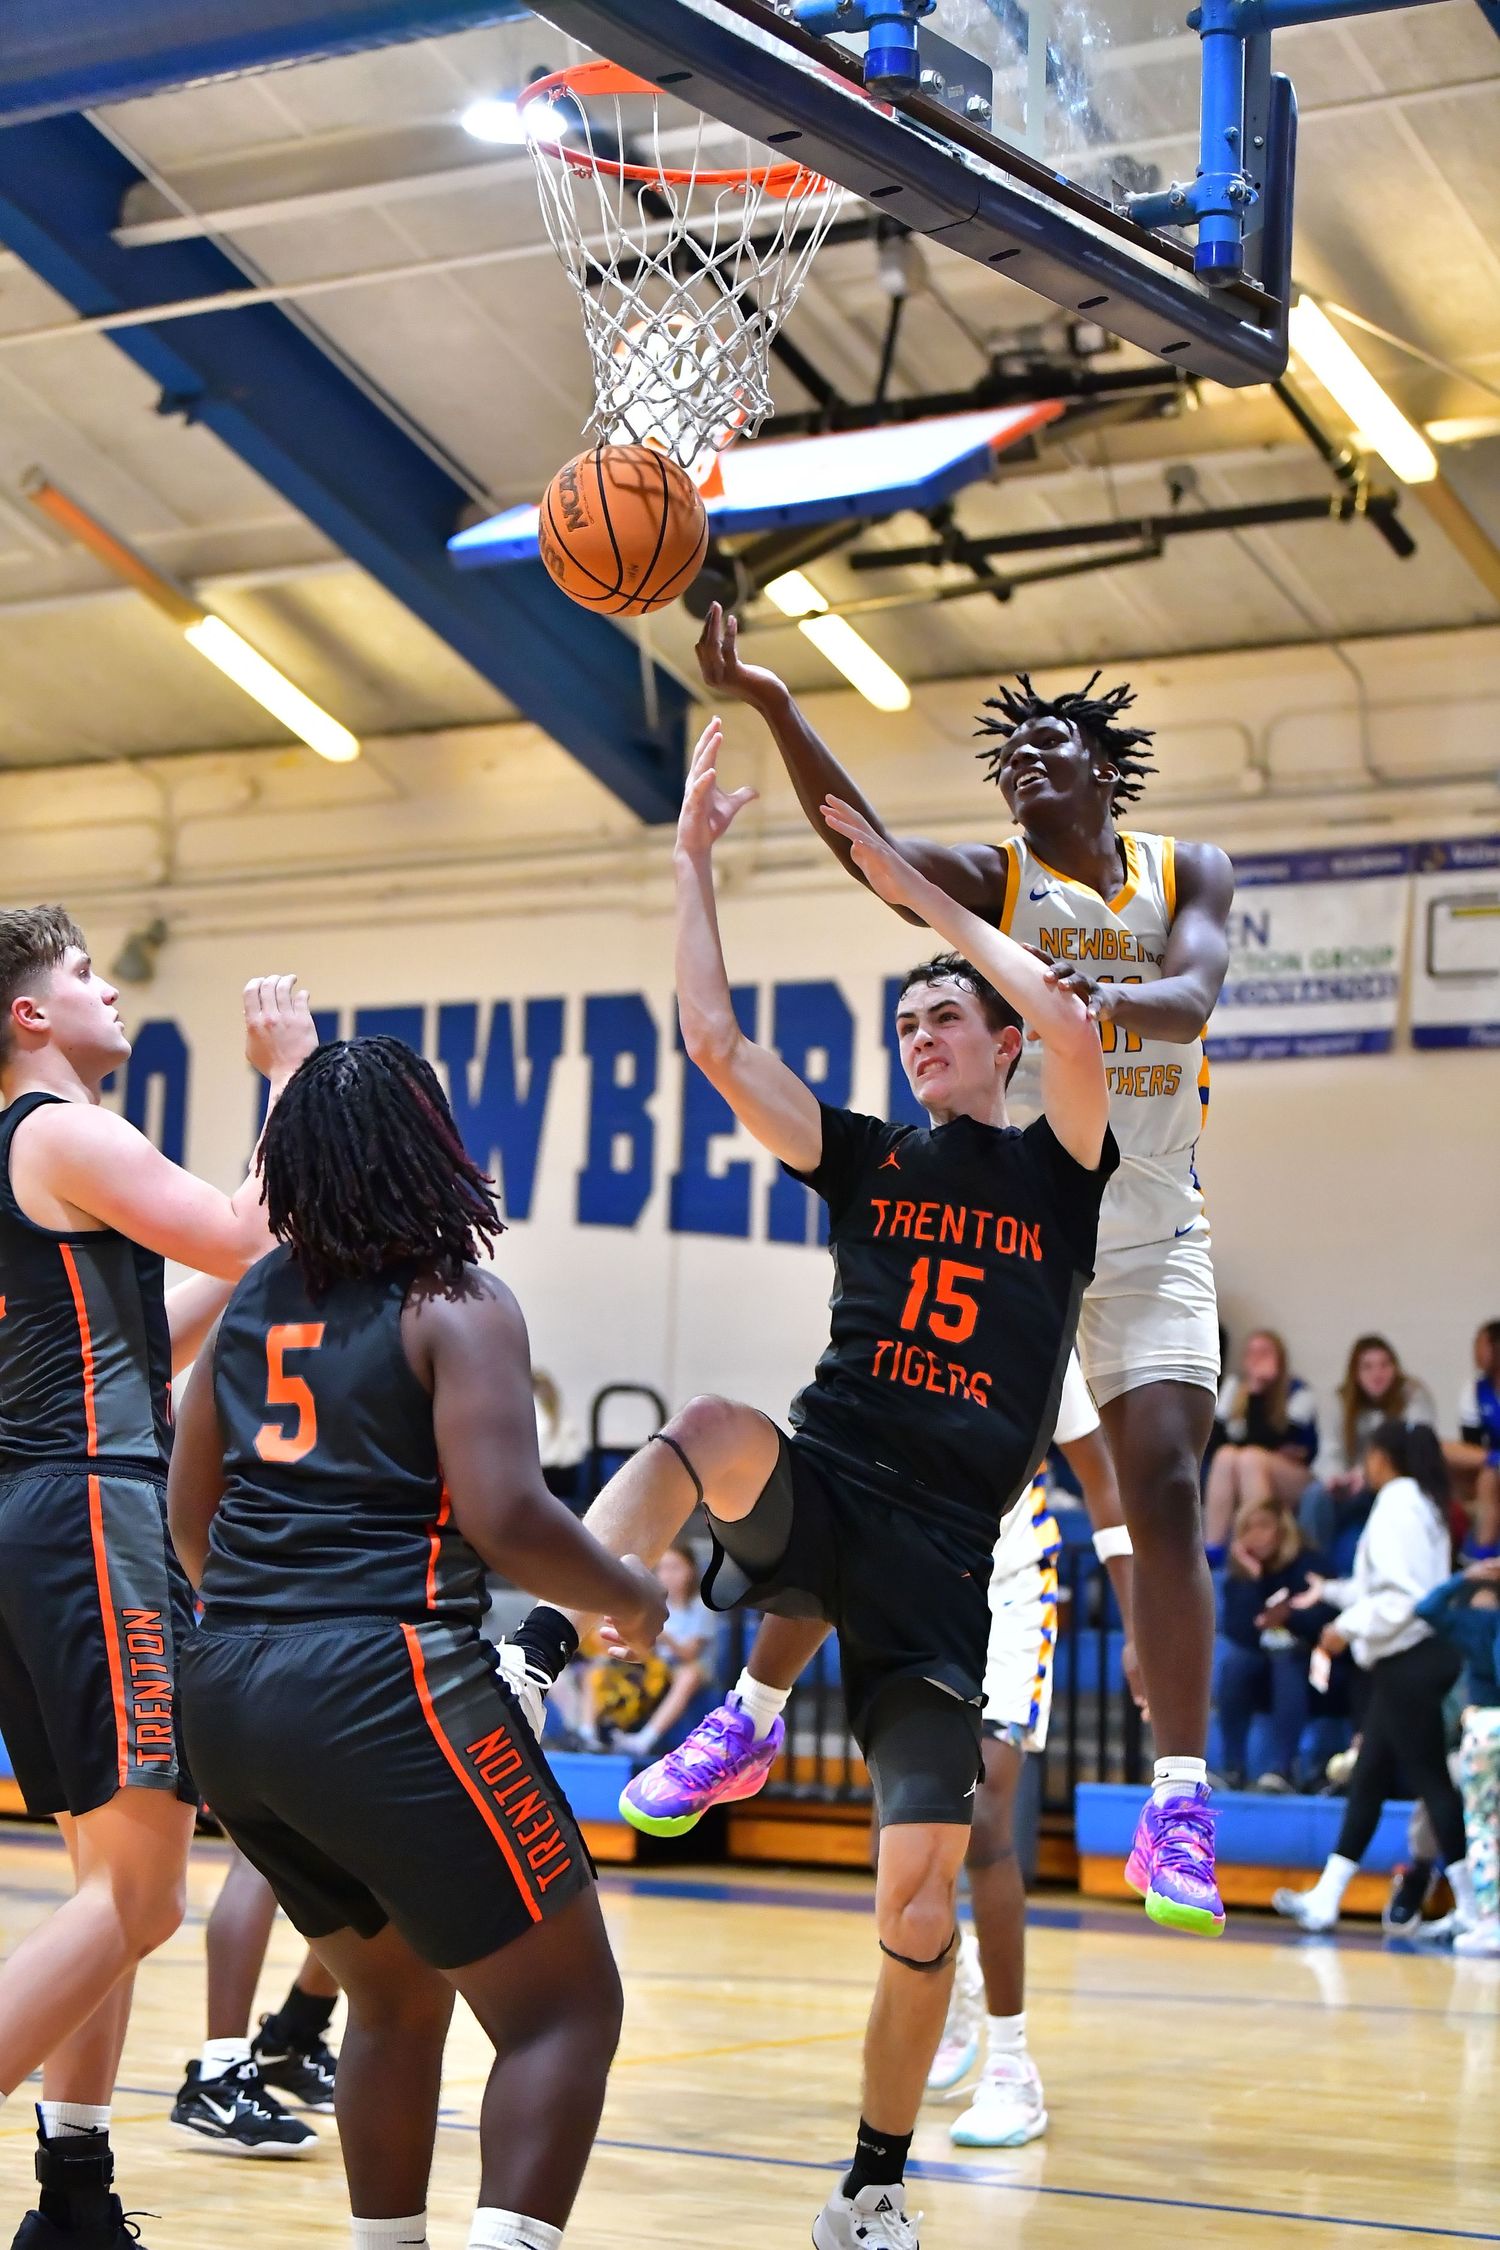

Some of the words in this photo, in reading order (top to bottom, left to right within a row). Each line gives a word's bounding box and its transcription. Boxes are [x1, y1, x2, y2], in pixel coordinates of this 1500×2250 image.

[1038, 927, 1164, 968] NEWBE
[1106, 1063, 1183, 1098] THERS
[870, 1198, 1043, 1262] TRENTON
[899, 1256, 985, 1344] 15
[252, 1321, 326, 1464] 5
[870, 1340, 993, 1409] TIGERS
[121, 1608, 173, 1768] TRENTON
[465, 1724, 572, 1894] TRENTON
